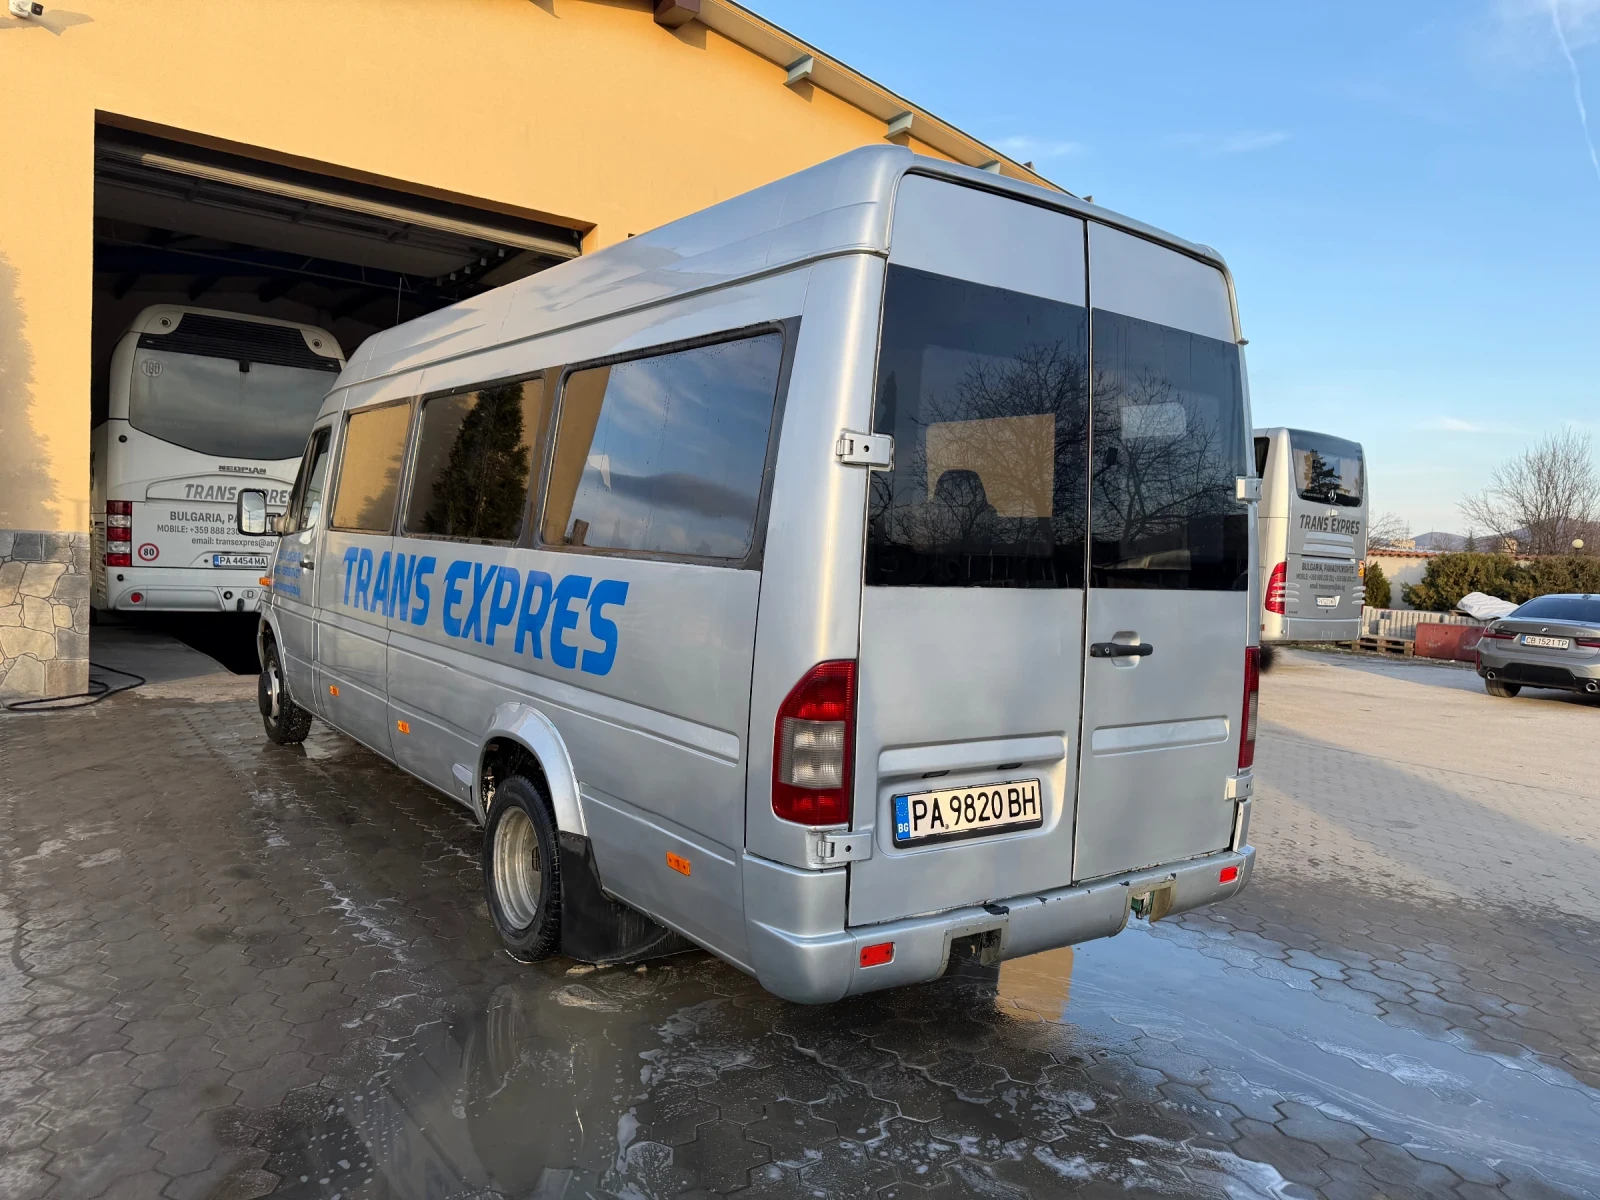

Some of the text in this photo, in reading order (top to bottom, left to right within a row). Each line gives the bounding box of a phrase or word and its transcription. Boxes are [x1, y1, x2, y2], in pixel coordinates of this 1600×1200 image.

[218, 465, 267, 474] NEOPLAN
[184, 483, 237, 501] TRANS
[169, 511, 225, 524] BULGARIA,
[157, 524, 188, 533] MOBILE:
[189, 526, 209, 534] +359
[210, 526, 225, 535] 888
[1300, 514, 1360, 535] TRANS EXPRES
[191, 536, 215, 545] email:
[143, 547, 155, 557] 80
[219, 556, 231, 565] PA
[233, 557, 253, 565] 4454
[343, 546, 630, 676] TRANS EXPRES
[1526, 636, 1536, 644] CB
[1537, 638, 1555, 646] 1521
[912, 785, 1037, 831] PA 9820 BH
[897, 822, 909, 833] BG
